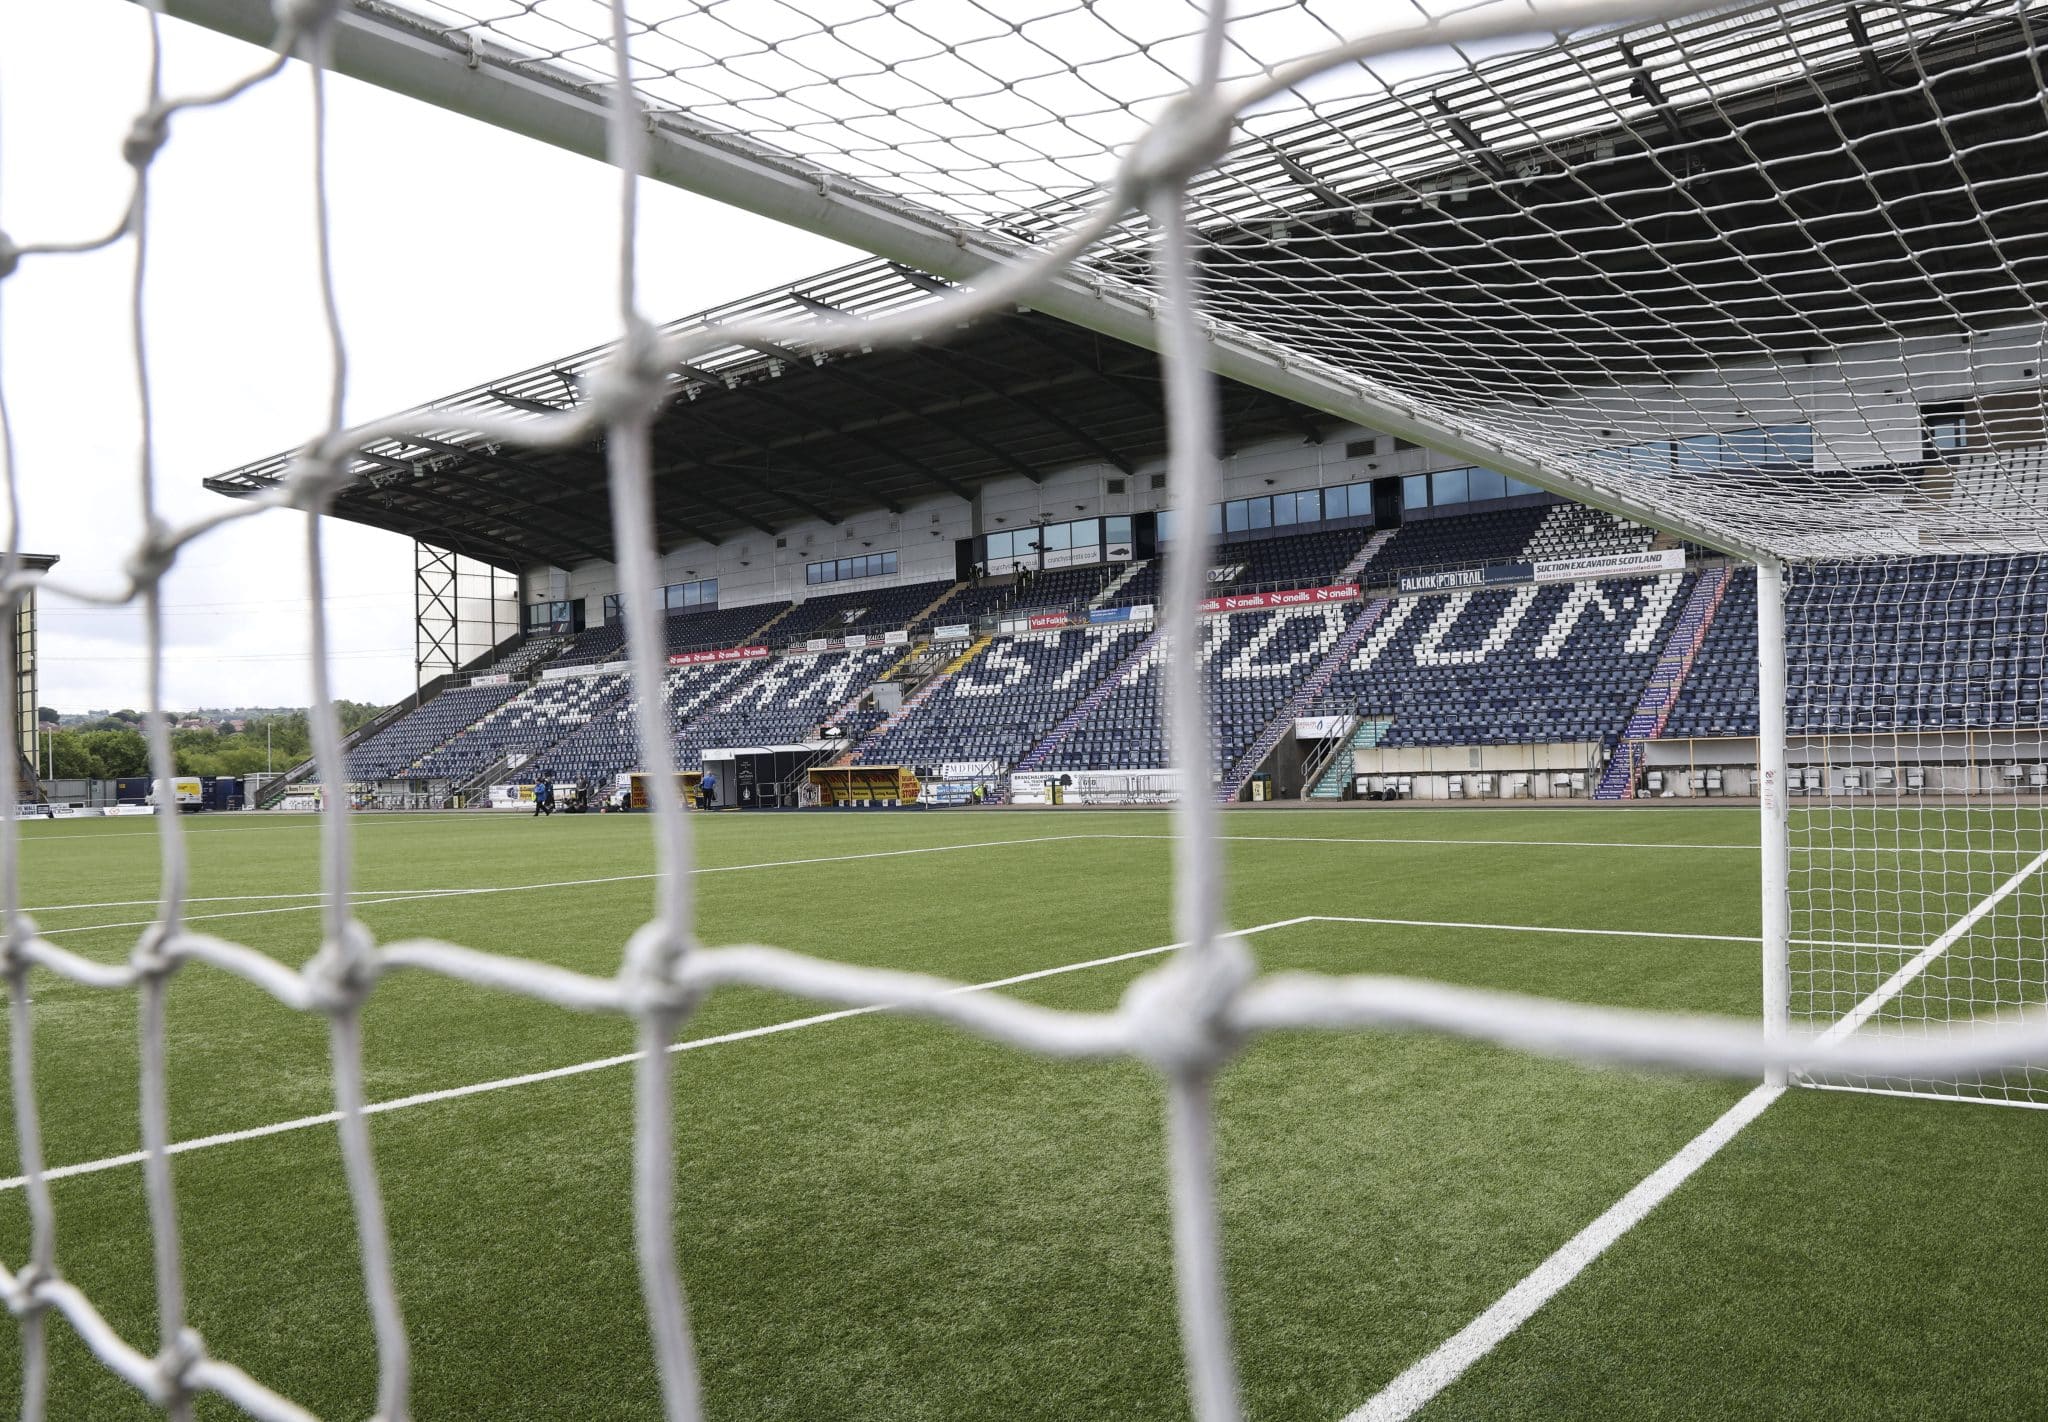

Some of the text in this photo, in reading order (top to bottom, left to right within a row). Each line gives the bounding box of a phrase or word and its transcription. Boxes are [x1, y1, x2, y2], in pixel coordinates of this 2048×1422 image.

[1047, 551, 1097, 564] crunchycarots.co.uk
[1536, 554, 1662, 573] SUCTION EXCAVATOR SCOTLAND
[1401, 570, 1484, 591] FALKIRK PUB TRAIL
[1283, 592, 1310, 603] oneills
[1329, 587, 1358, 598] oneills
[1198, 601, 1220, 610] neills
[1237, 597, 1264, 607] oneills
[1032, 615, 1069, 627] Visit Falkirk
